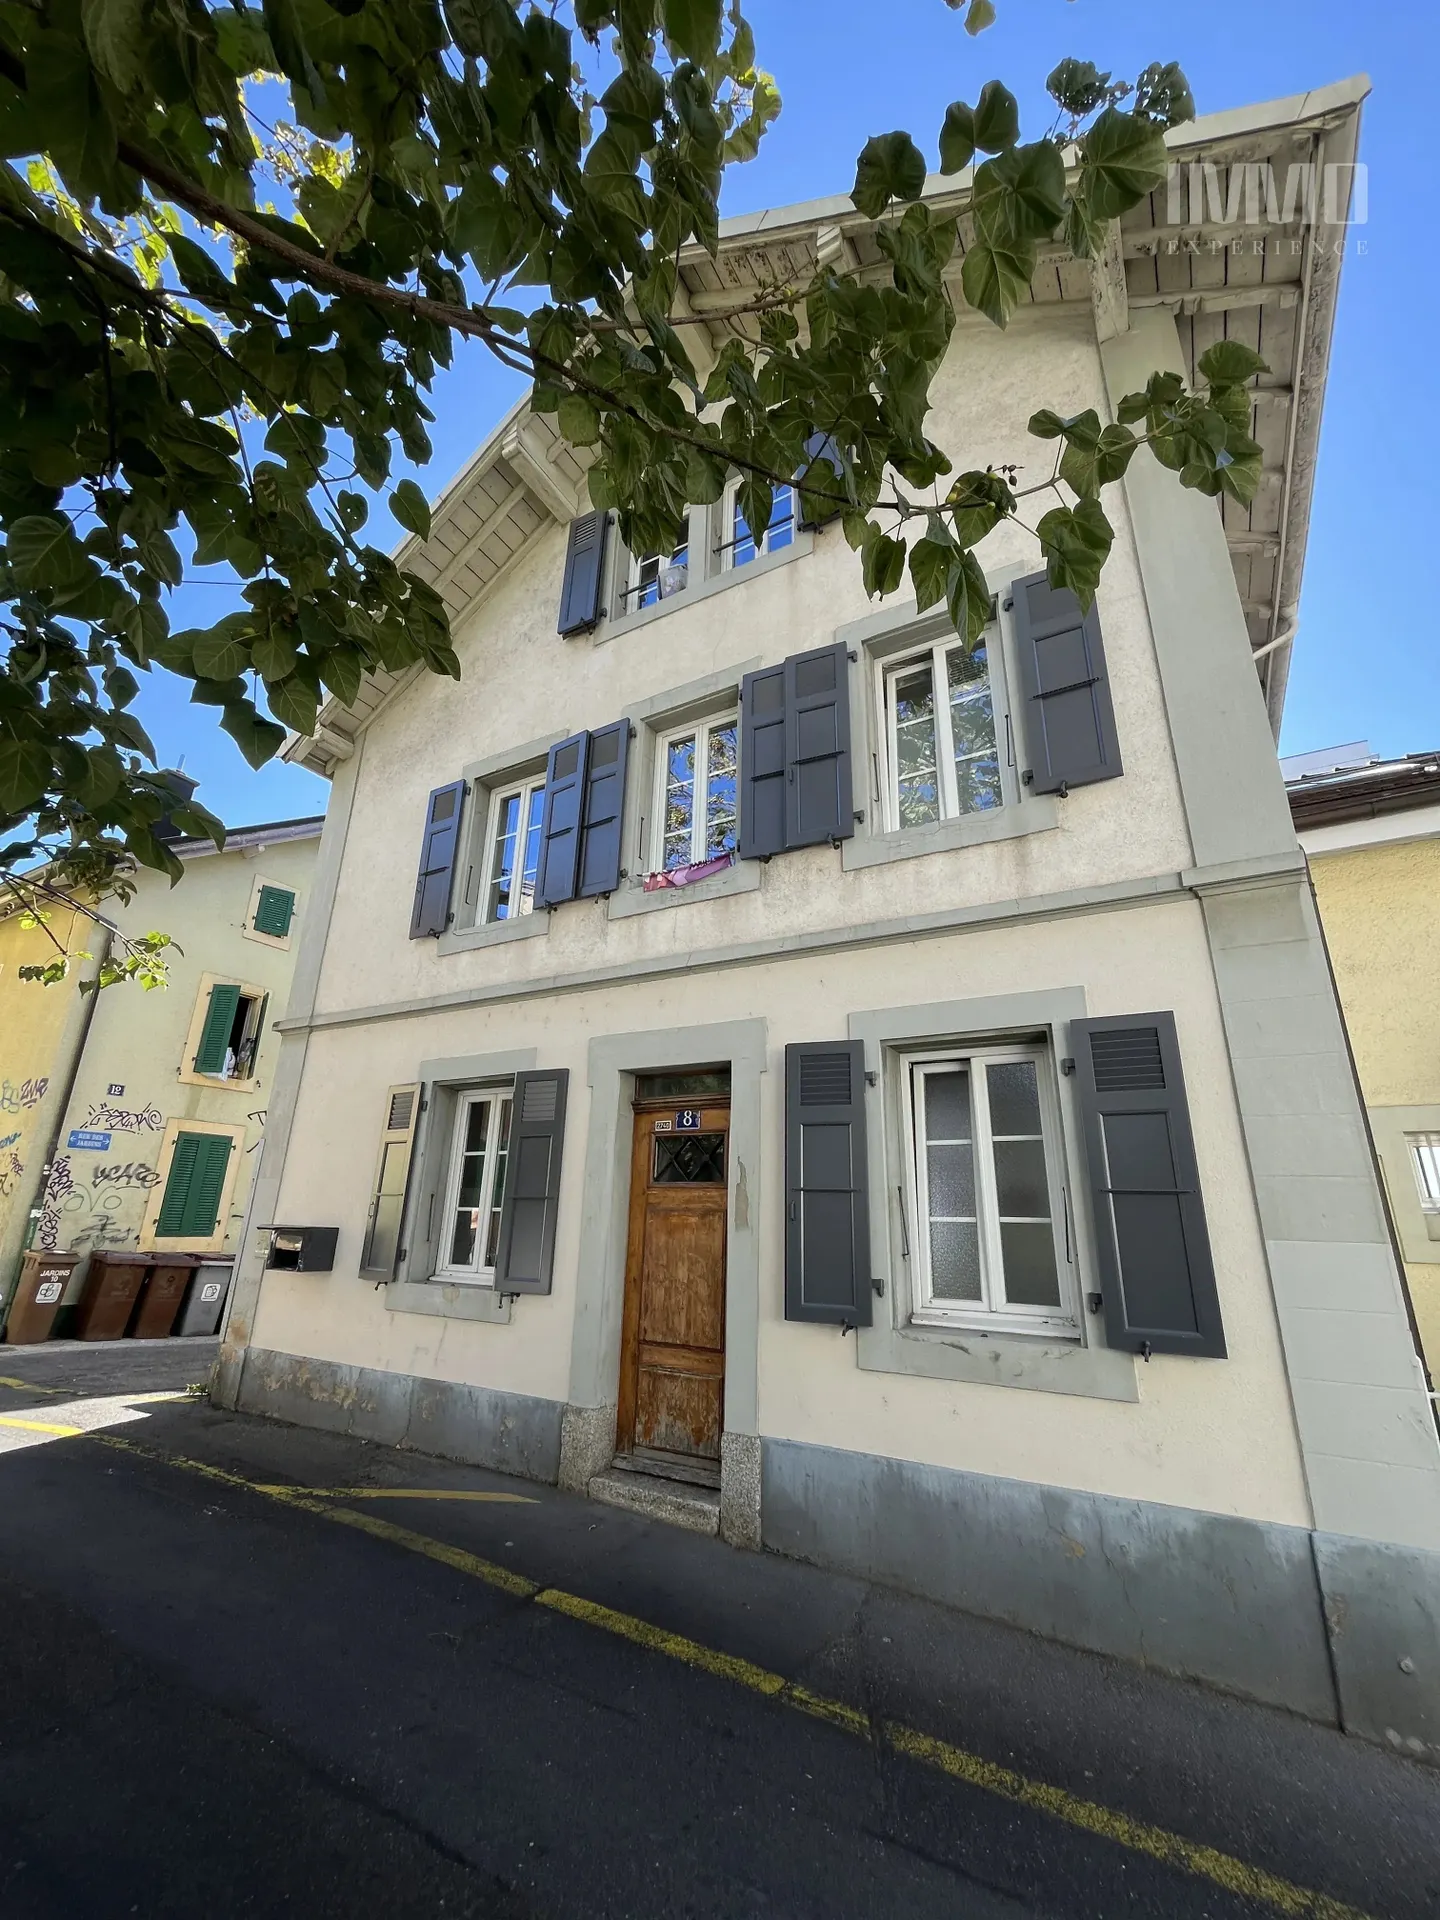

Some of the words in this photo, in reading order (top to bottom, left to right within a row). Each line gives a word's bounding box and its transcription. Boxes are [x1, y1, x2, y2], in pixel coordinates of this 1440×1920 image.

[110, 1085, 122, 1095] 12
[683, 1110, 692, 1126] 8
[40, 1269, 71, 1277] JARDINS
